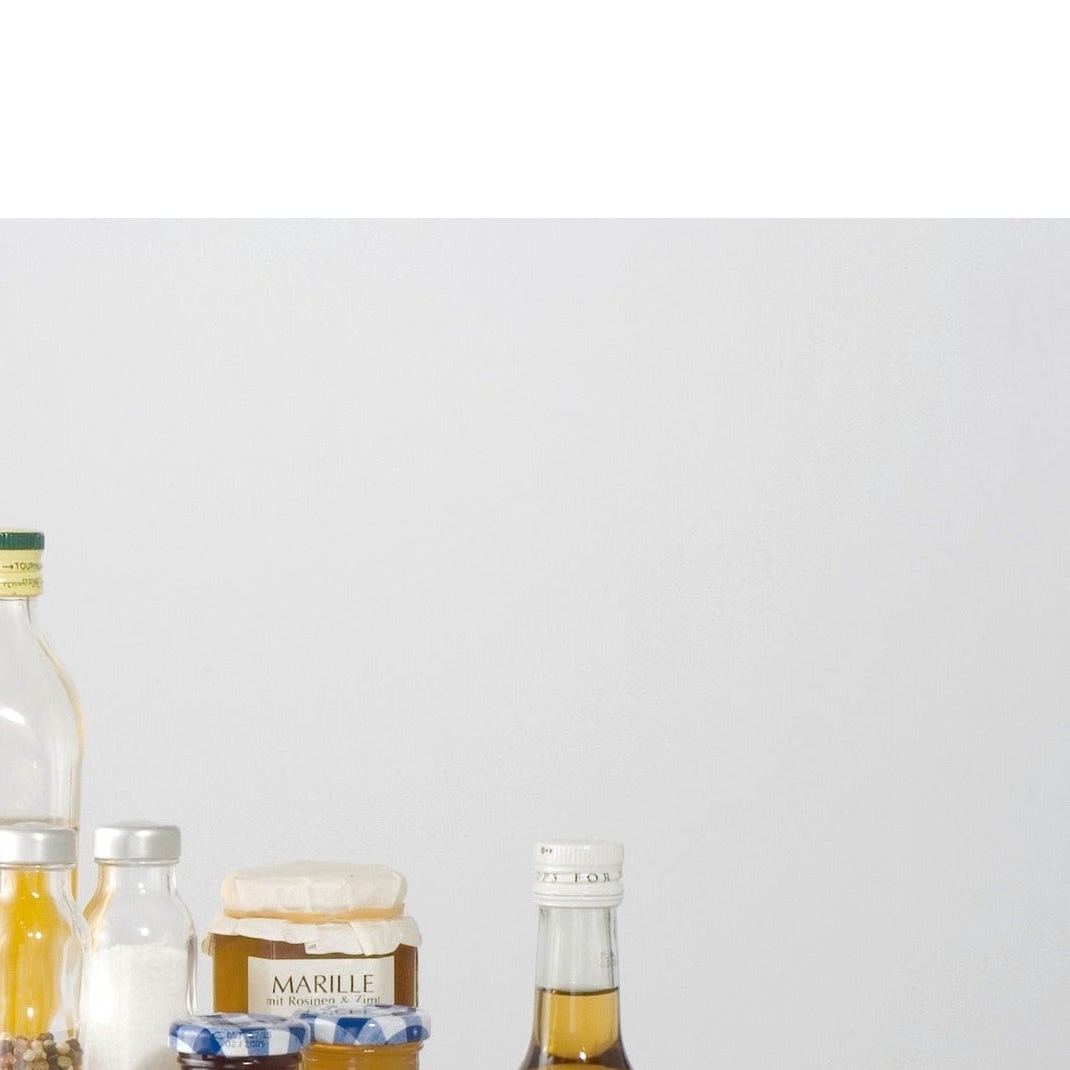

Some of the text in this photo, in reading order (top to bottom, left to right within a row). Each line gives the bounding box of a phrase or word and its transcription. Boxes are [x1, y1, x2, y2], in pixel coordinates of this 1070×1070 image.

[272, 975, 374, 994] MARILLE
[267, 996, 283, 1006] mit
[288, 995, 335, 1007] Rosinen
